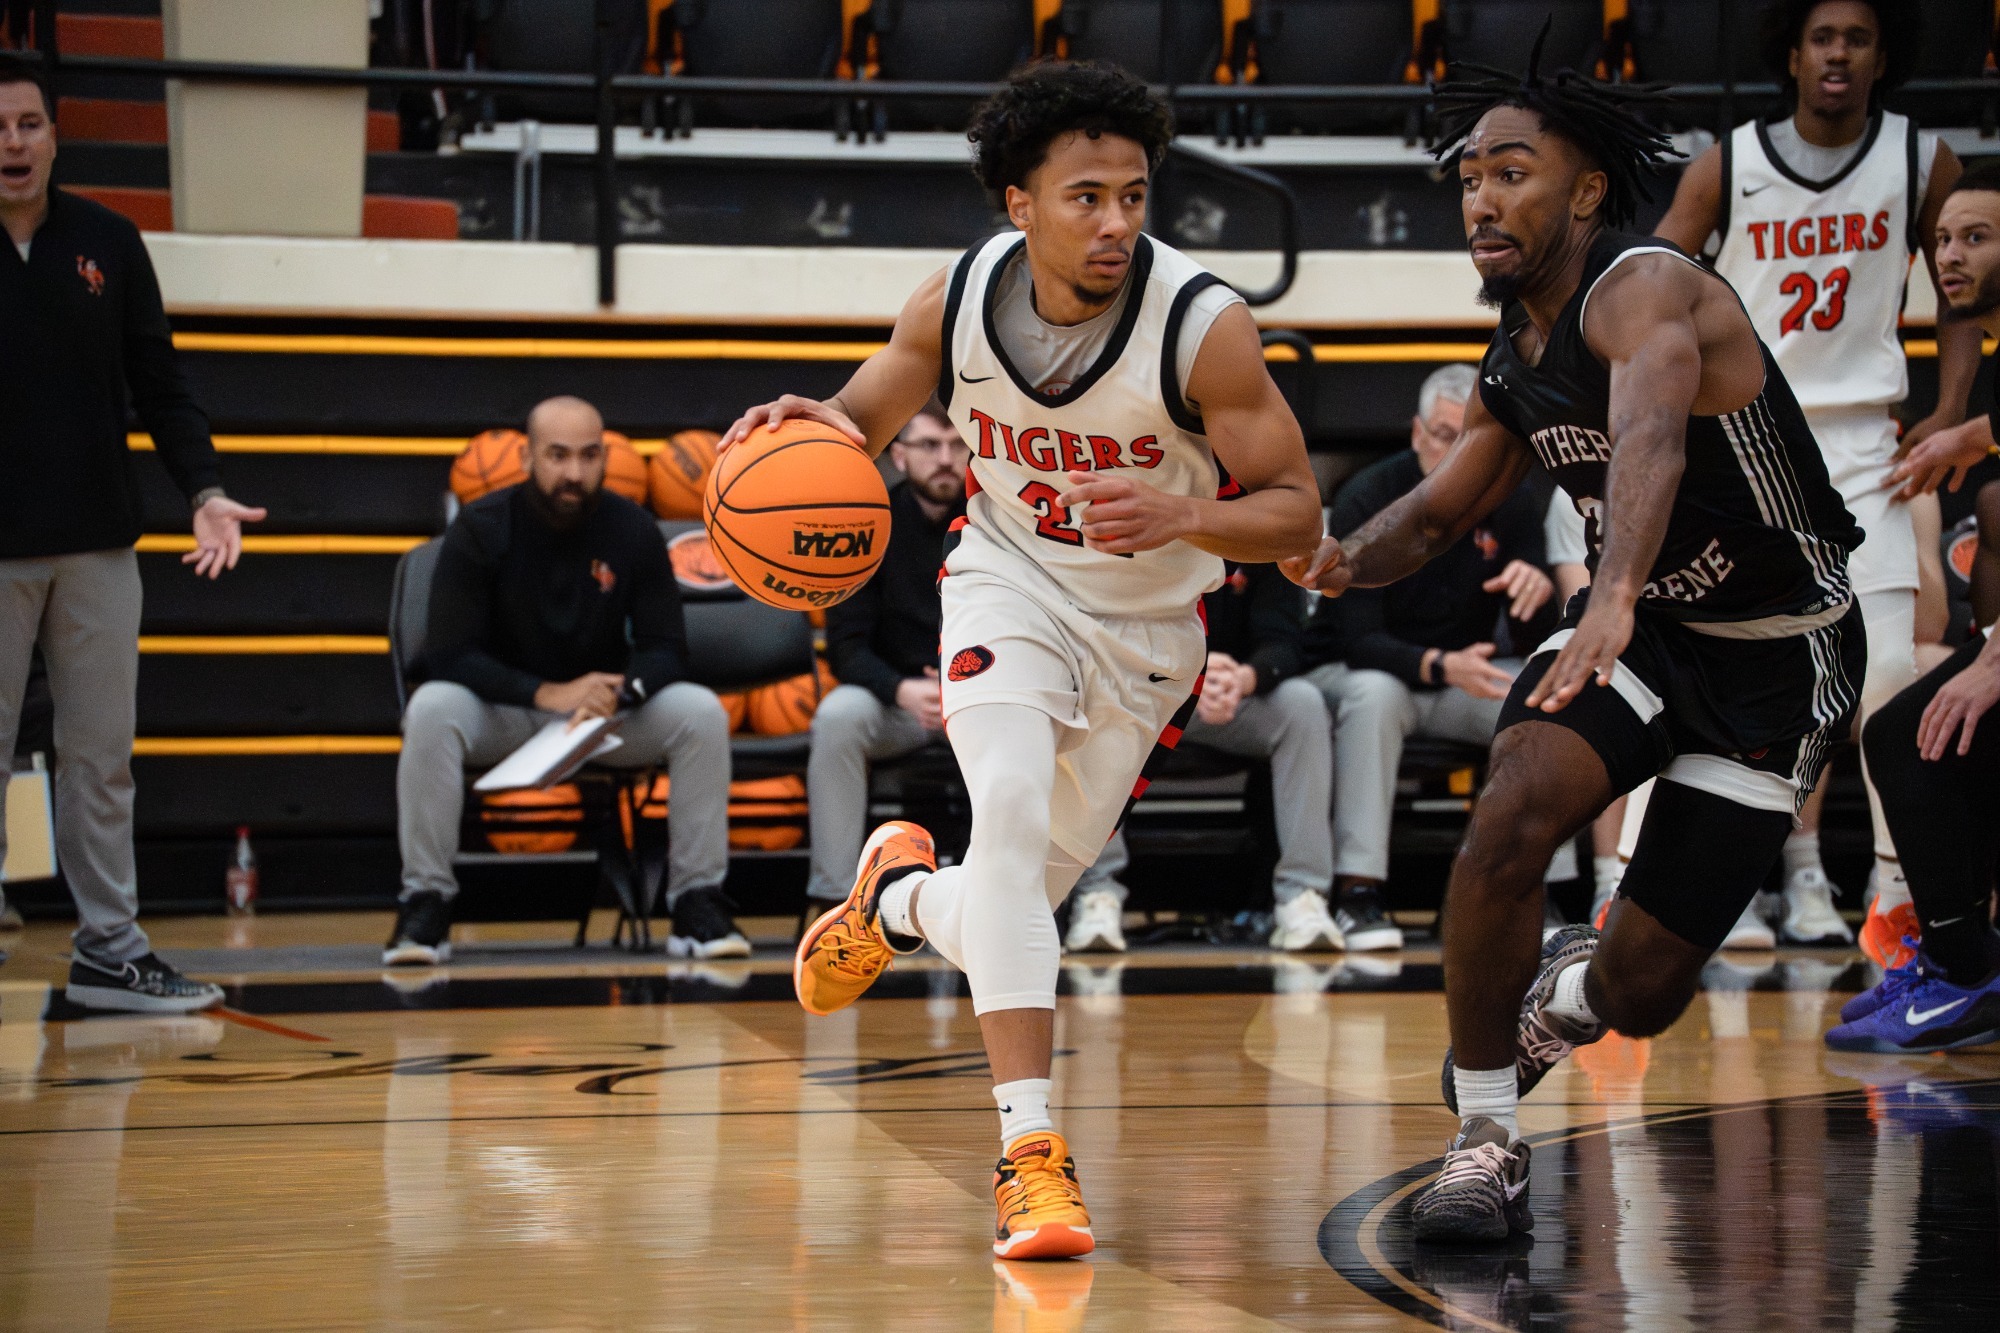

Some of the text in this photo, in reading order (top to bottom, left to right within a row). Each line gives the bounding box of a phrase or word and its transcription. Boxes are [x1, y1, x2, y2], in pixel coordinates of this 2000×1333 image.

[1747, 210, 1889, 261] TIGERS
[1779, 266, 1850, 338] 23
[968, 407, 1165, 472] TIGERS
[793, 528, 875, 558] NCAA
